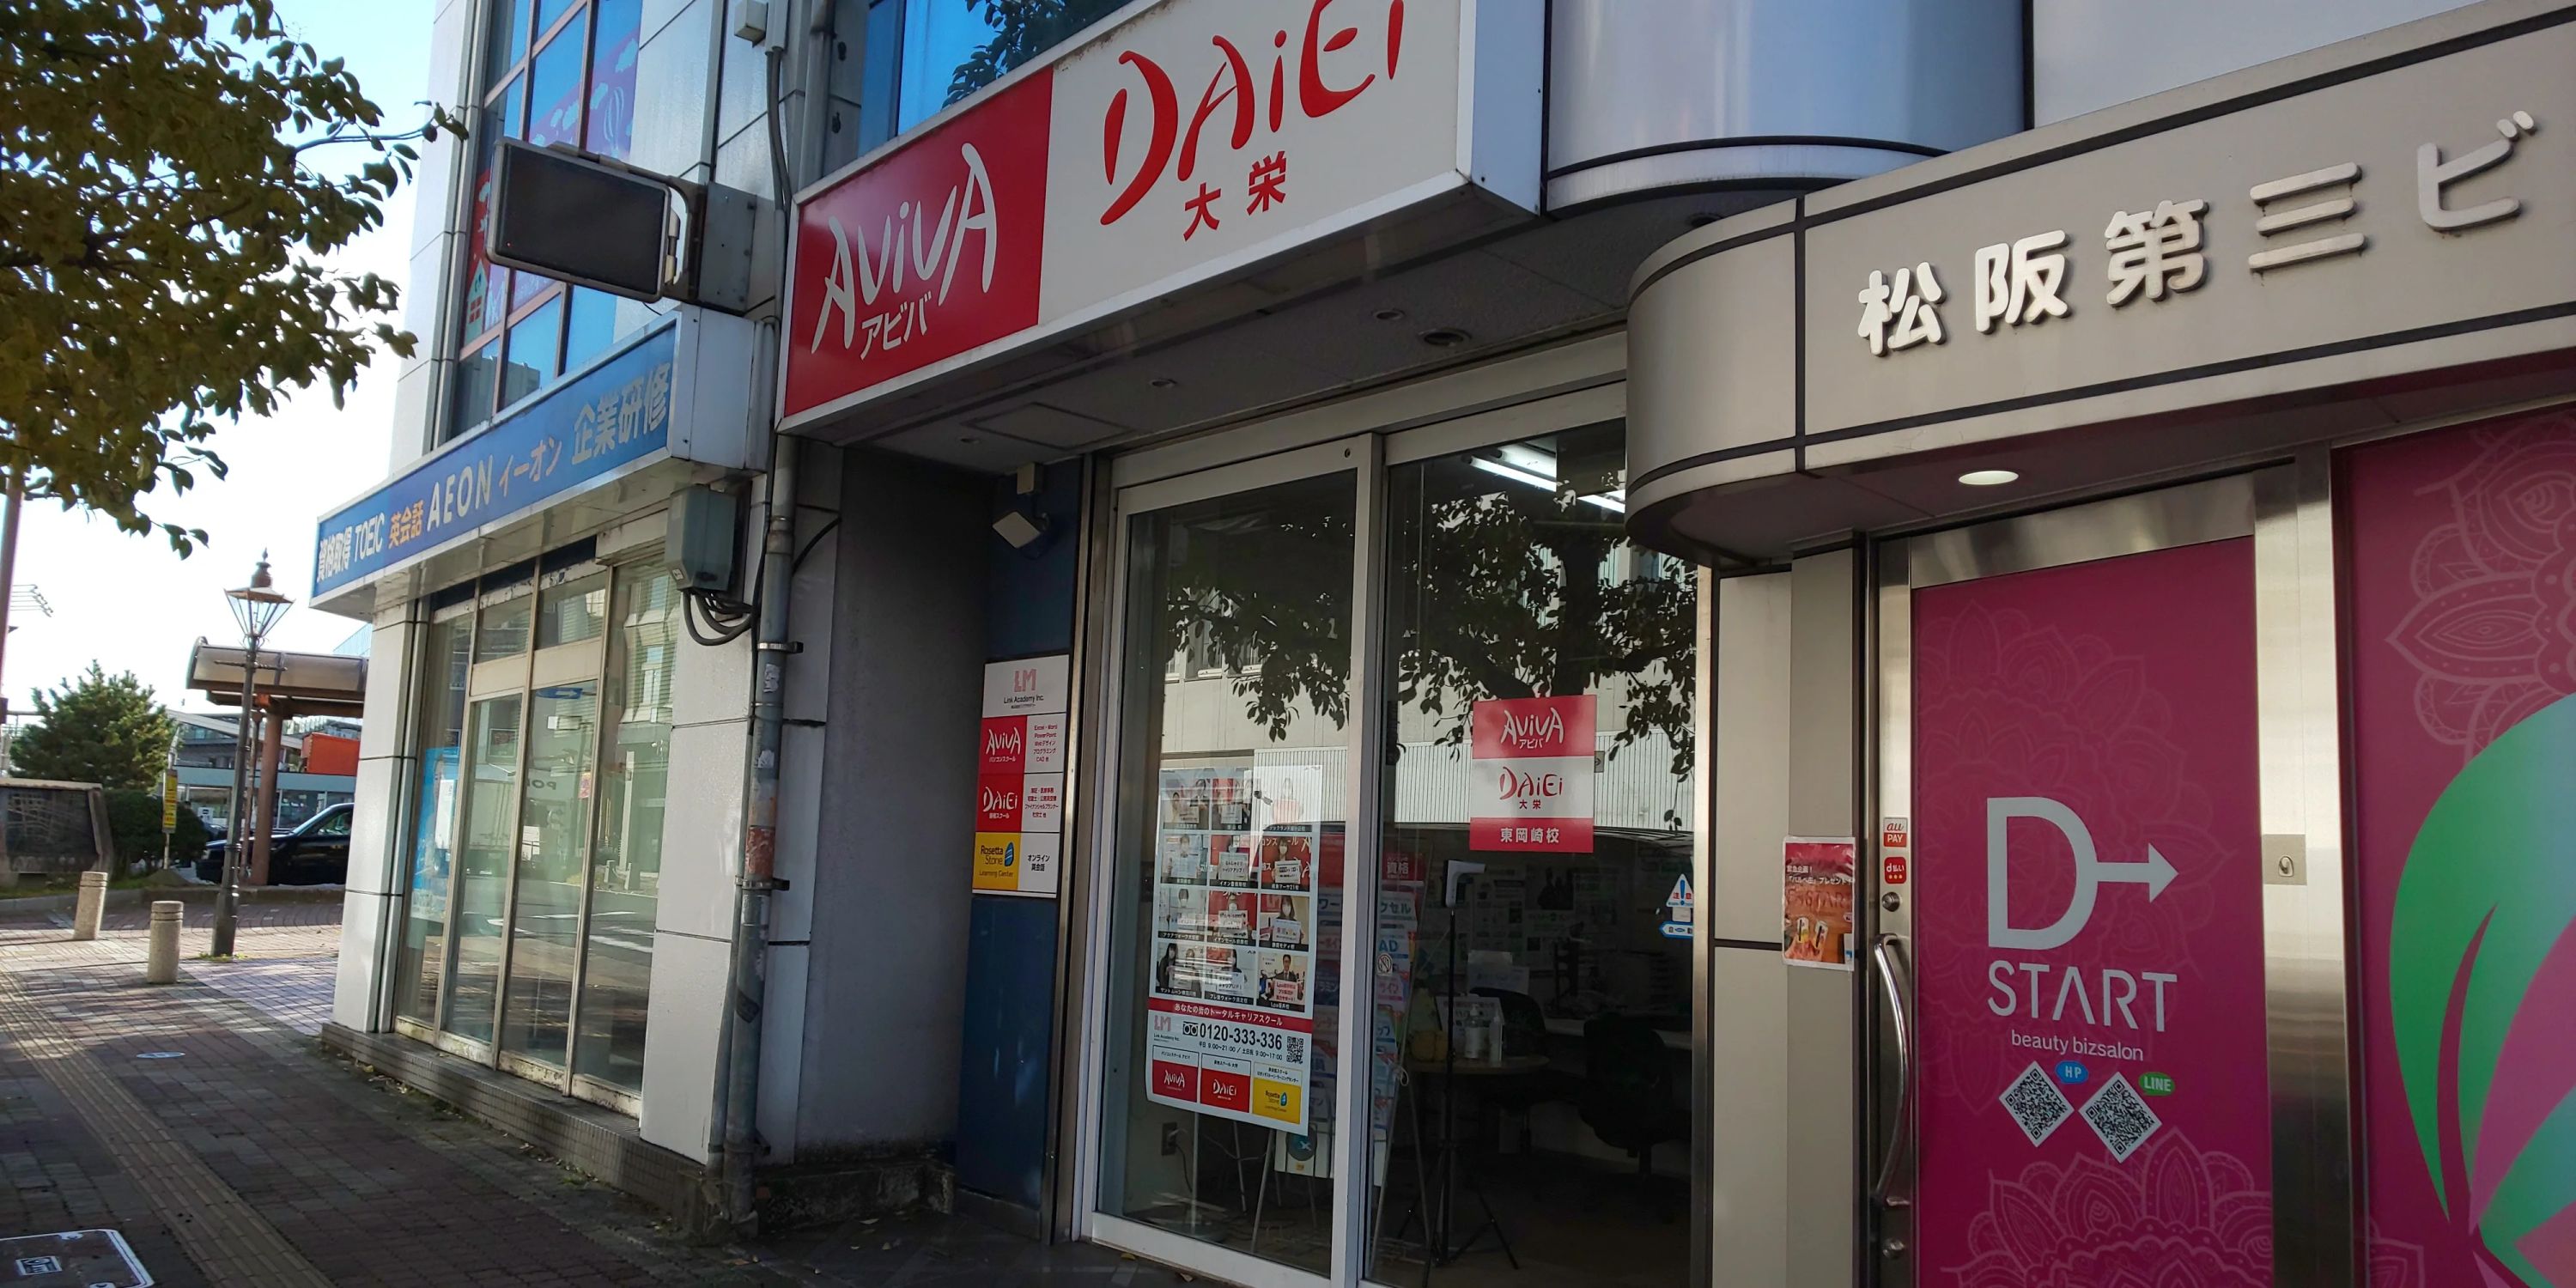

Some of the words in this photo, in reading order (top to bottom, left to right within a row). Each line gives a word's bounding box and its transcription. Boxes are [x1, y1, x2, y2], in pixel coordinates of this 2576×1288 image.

[1183, 150, 1287, 241] 大栄
[1857, 110, 2538, 358] 松阪第三ビ
[860, 290, 932, 361] アビバ
[354, 513, 385, 562] TOEIC
[389, 500, 423, 549] 英会話
[427, 454, 494, 532] AEON
[498, 436, 562, 497] イーオン
[572, 362, 671, 465] 企業研修
[1519, 738, 1543, 749] アビバ
[1519, 799, 1541, 810] 大栄
[1886, 823, 1904, 831] au
[1500, 827, 1559, 844] 東岡崎校
[1887, 834, 1904, 842] PAY
[981, 845, 1003, 855] Rosetta
[985, 855, 1003, 865] Stone
[1027, 854, 1050, 863] オンライン
[1987, 959, 2178, 1032] START
[1200, 1023, 1282, 1050] 0120-333-336
[2011, 1030, 2069, 1055] beauty
[2073, 1036, 2144, 1061] bizsalon
[2064, 1065, 2082, 1079] HP
[2143, 1077, 2172, 1091] LINE
